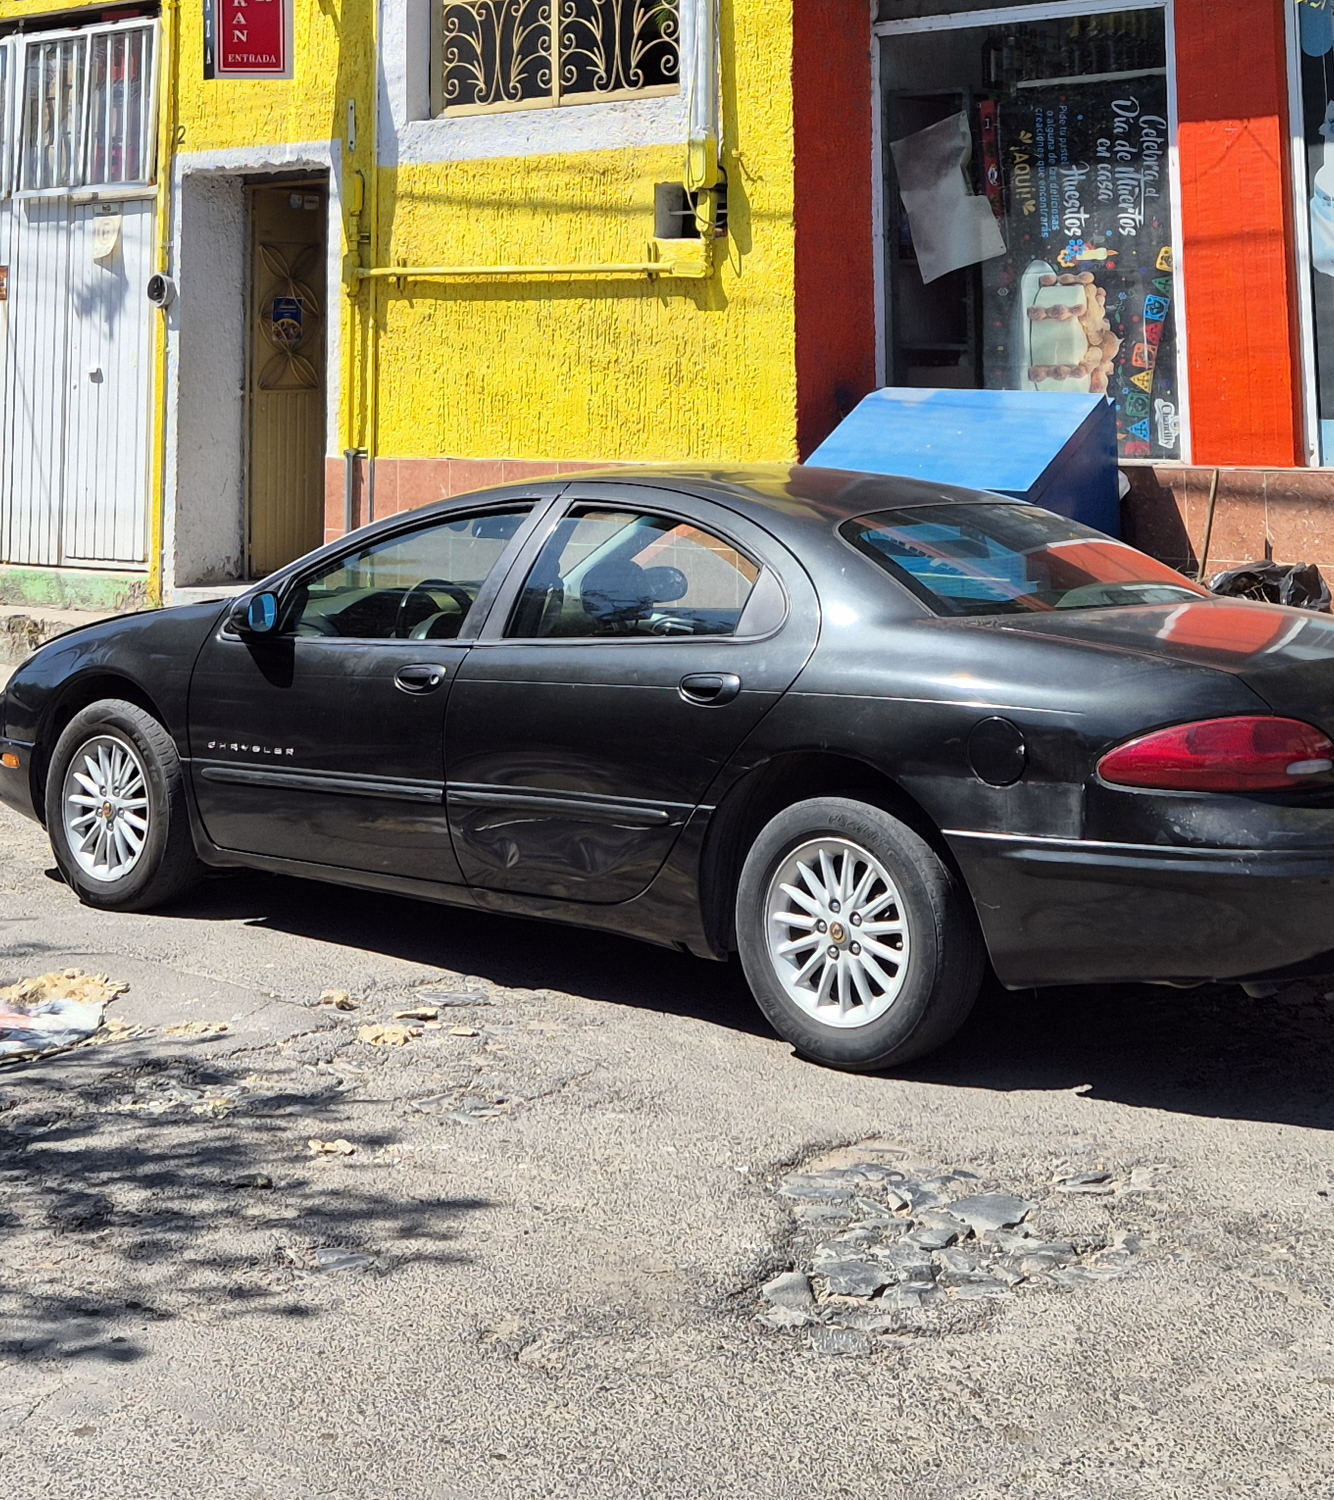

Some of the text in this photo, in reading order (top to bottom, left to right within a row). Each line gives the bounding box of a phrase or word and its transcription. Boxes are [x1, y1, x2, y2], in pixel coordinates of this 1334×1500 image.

[228, 53, 276, 64] ENTRADA
[1058, 105, 1067, 125] Pide
[1045, 118, 1055, 150] alguna
[1047, 152, 1058, 164] de
[1113, 140, 1138, 162] de
[1096, 138, 1113, 203] en casa
[1049, 182, 1060, 231] deliciosas
[1115, 166, 1145, 236] Muertos
[207, 741, 294, 756] CHRYSLER
